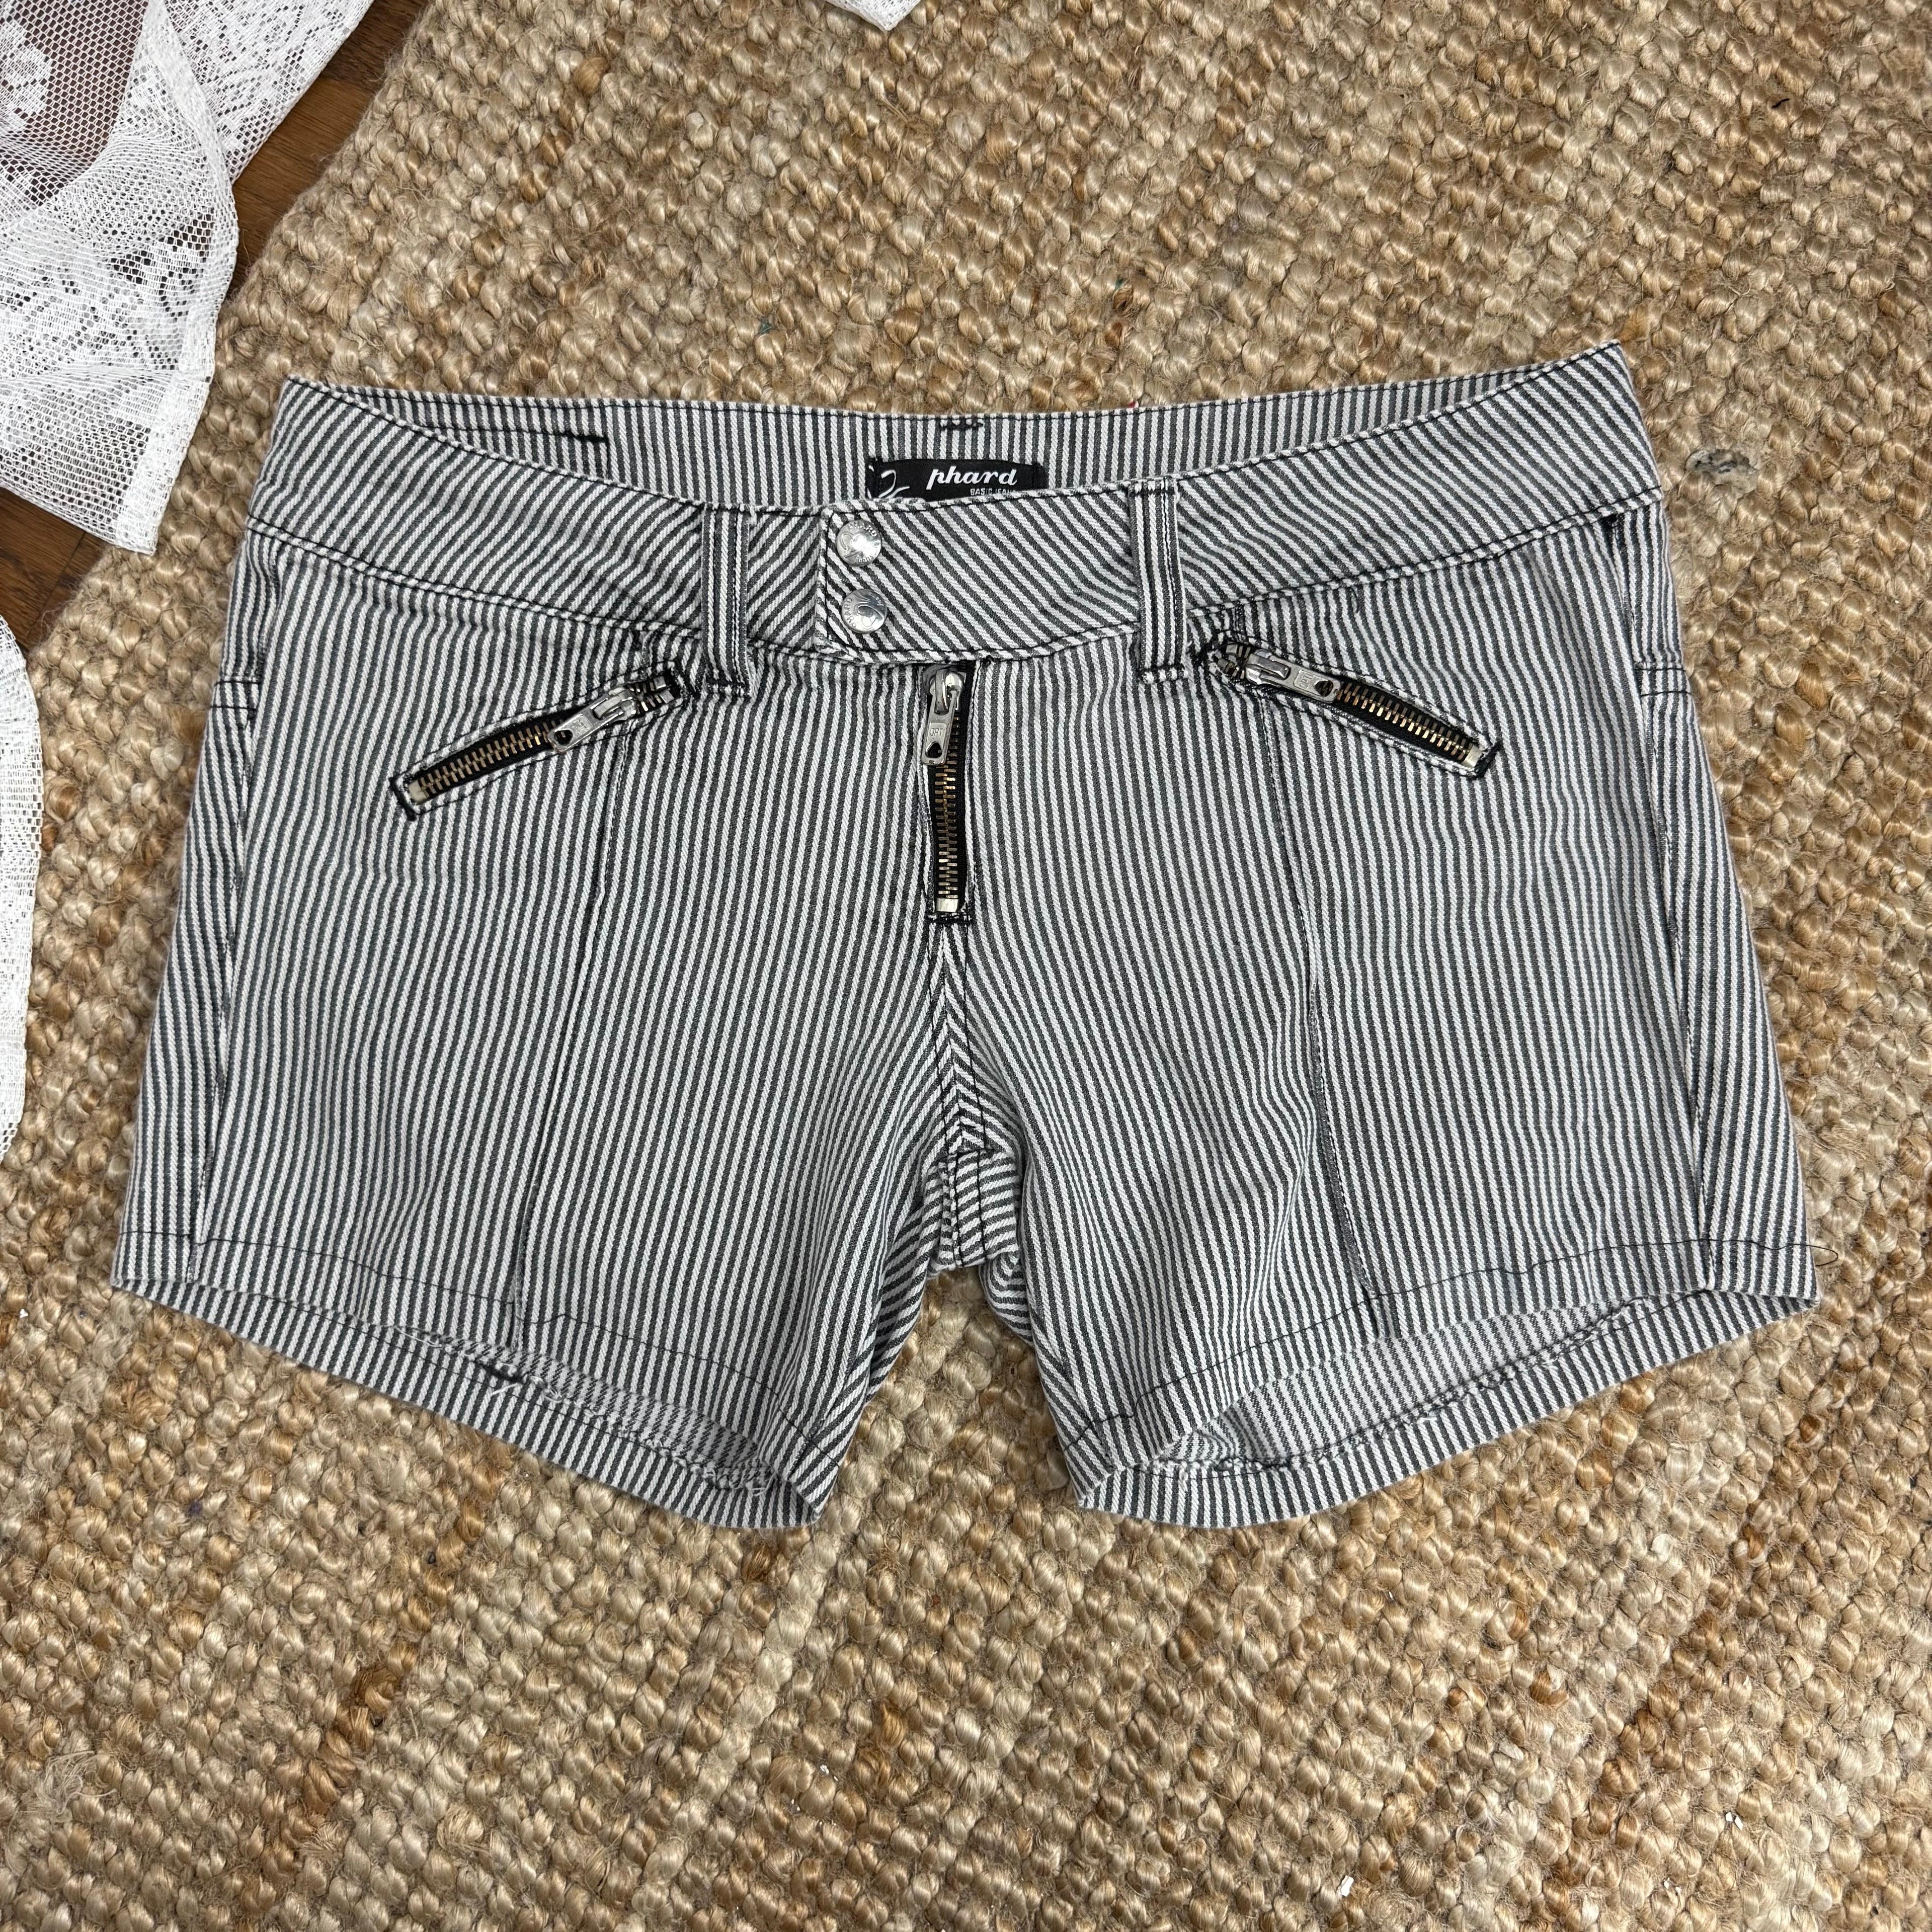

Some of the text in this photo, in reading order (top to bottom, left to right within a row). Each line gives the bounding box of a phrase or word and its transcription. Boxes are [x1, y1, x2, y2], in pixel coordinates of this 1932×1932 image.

[926, 466, 1017, 490] phard
[970, 488, 993, 496] BASIC
[930, 728, 945, 737] OPTI
